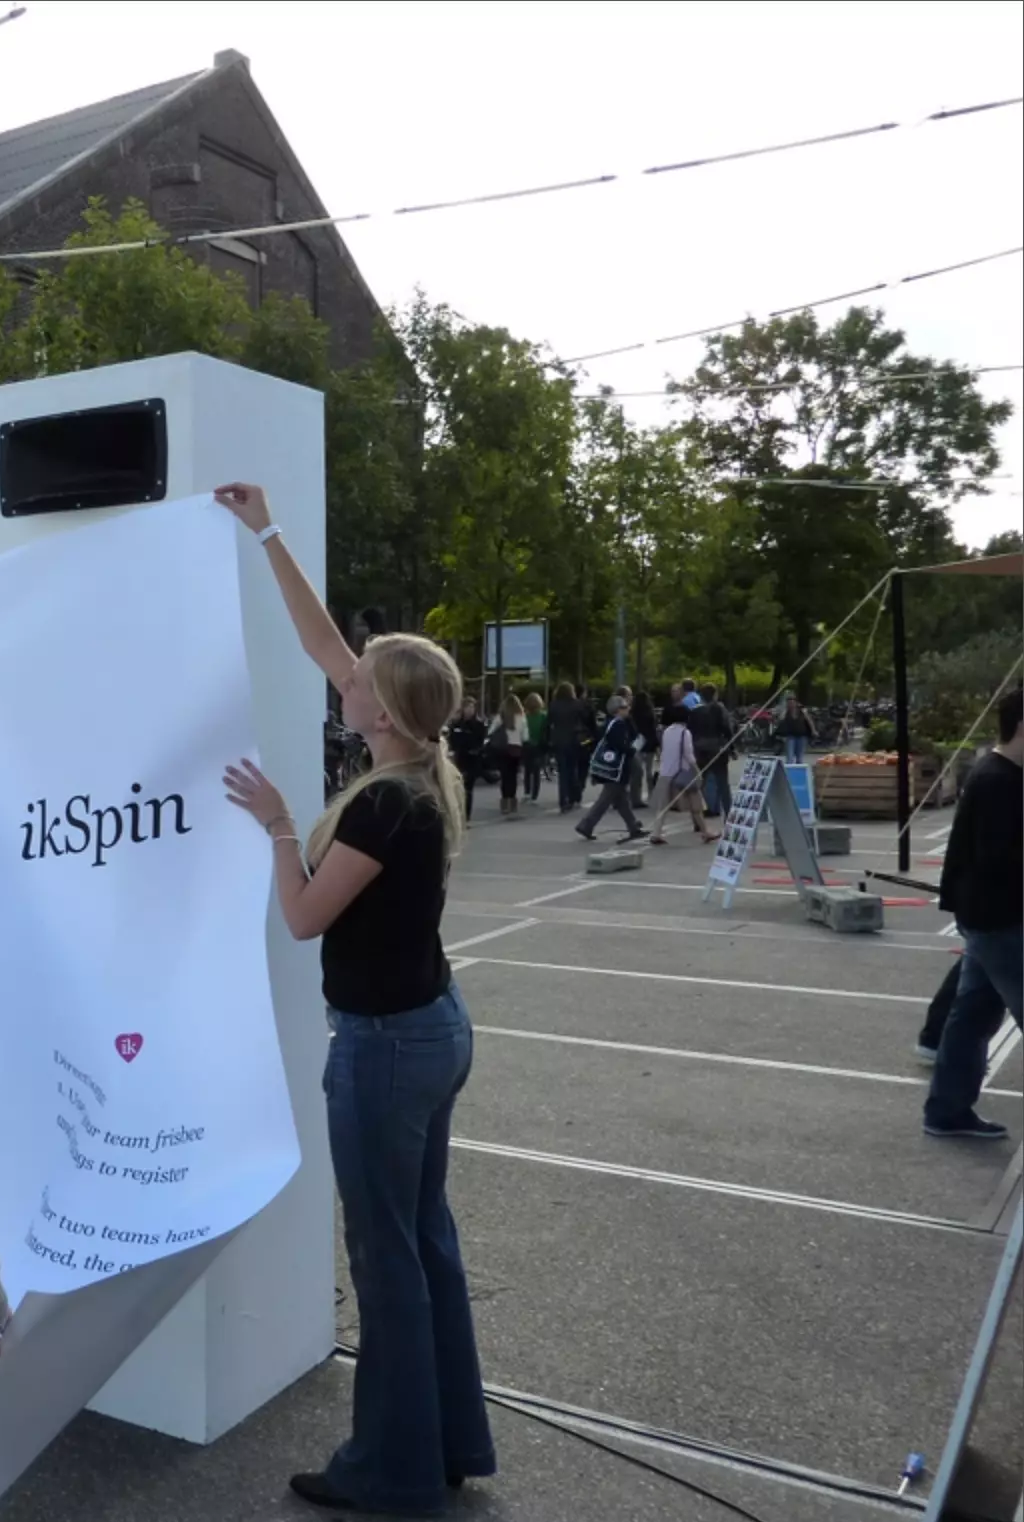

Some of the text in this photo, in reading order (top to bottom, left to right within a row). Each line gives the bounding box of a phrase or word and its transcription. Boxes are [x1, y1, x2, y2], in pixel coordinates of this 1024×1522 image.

[20, 782, 192, 867] ikSpin
[121, 1038, 137, 1055] ik
[103, 1130, 150, 1149] team
[150, 1124, 205, 1154] frisbee
[98, 1161, 117, 1176] to
[122, 1165, 189, 1185] register
[58, 1215, 211, 1245] two teams have
[83, 1253, 115, 1273] the
